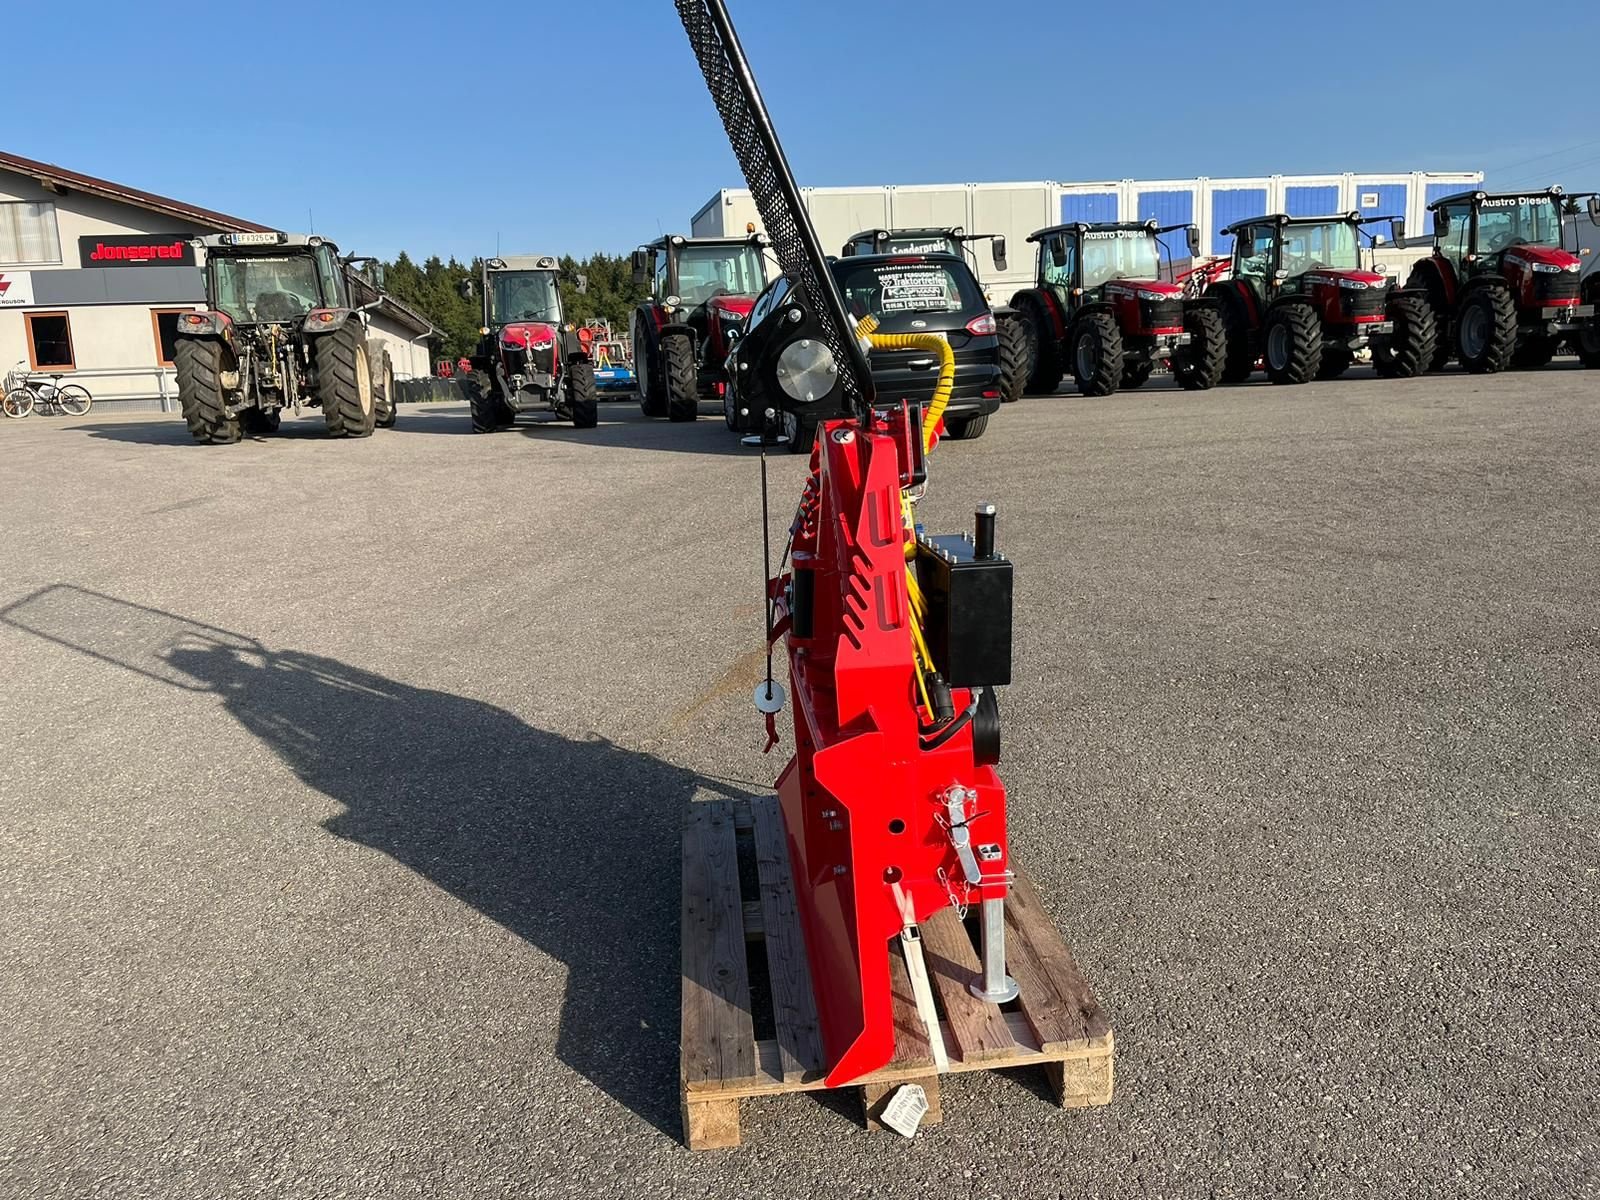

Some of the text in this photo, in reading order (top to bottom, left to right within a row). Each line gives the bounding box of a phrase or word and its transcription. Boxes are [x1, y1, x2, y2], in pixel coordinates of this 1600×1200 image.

[1481, 196, 1550, 207] Austro Diesel
[1083, 230, 1147, 240] Austro Diesel
[90, 242, 183, 260] Jonsered
[892, 240, 946, 254] Sonderpreis
